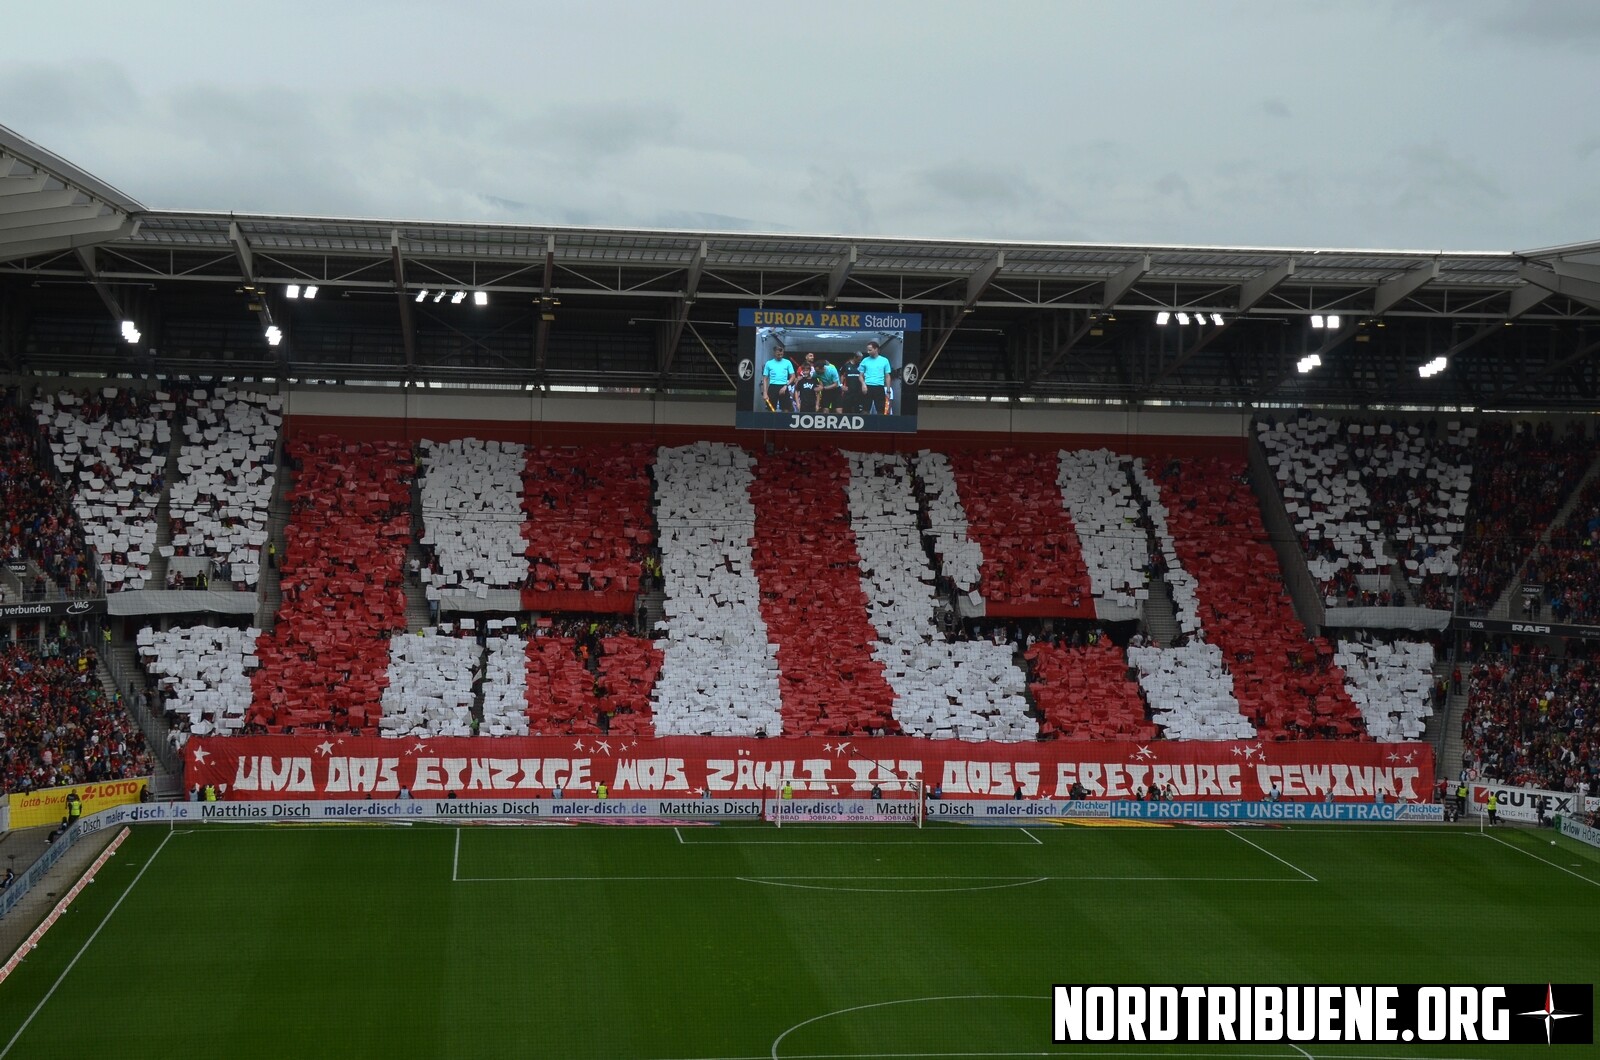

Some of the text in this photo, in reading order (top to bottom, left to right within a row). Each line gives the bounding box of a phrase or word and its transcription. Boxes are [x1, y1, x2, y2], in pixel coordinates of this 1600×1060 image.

[754, 311, 907, 328] EUROPA PARK Stadion
[789, 414, 865, 430] JOBRAD
[5, 605, 51, 615] verbunden
[73, 601, 89, 609] VAG
[1512, 623, 1550, 633] RAFI
[233, 755, 316, 791] UND
[324, 757, 400, 792] DAS
[613, 758, 689, 790] WAS
[942, 760, 1040, 796] DASS
[1055, 762, 1241, 797] FREIBURG
[1256, 764, 1419, 799] GEWINNT
[99, 782, 138, 798] LOTTO
[20, 794, 66, 809] lotto-bw.d
[660, 802, 719, 814] Matthias
[724, 802, 760, 814] Disch
[1076, 801, 1109, 809] Richter
[1495, 790, 1571, 812] GUTEX
[202, 803, 423, 817] Matthias Disch maler-disch.de
[436, 802, 647, 815] Matthias Disch maler-disch.de
[940, 803, 974, 815] Disch
[1112, 802, 1393, 819] IHR PROFIL IST UNSER AUFTRAG
[1409, 805, 1442, 813] Richter
